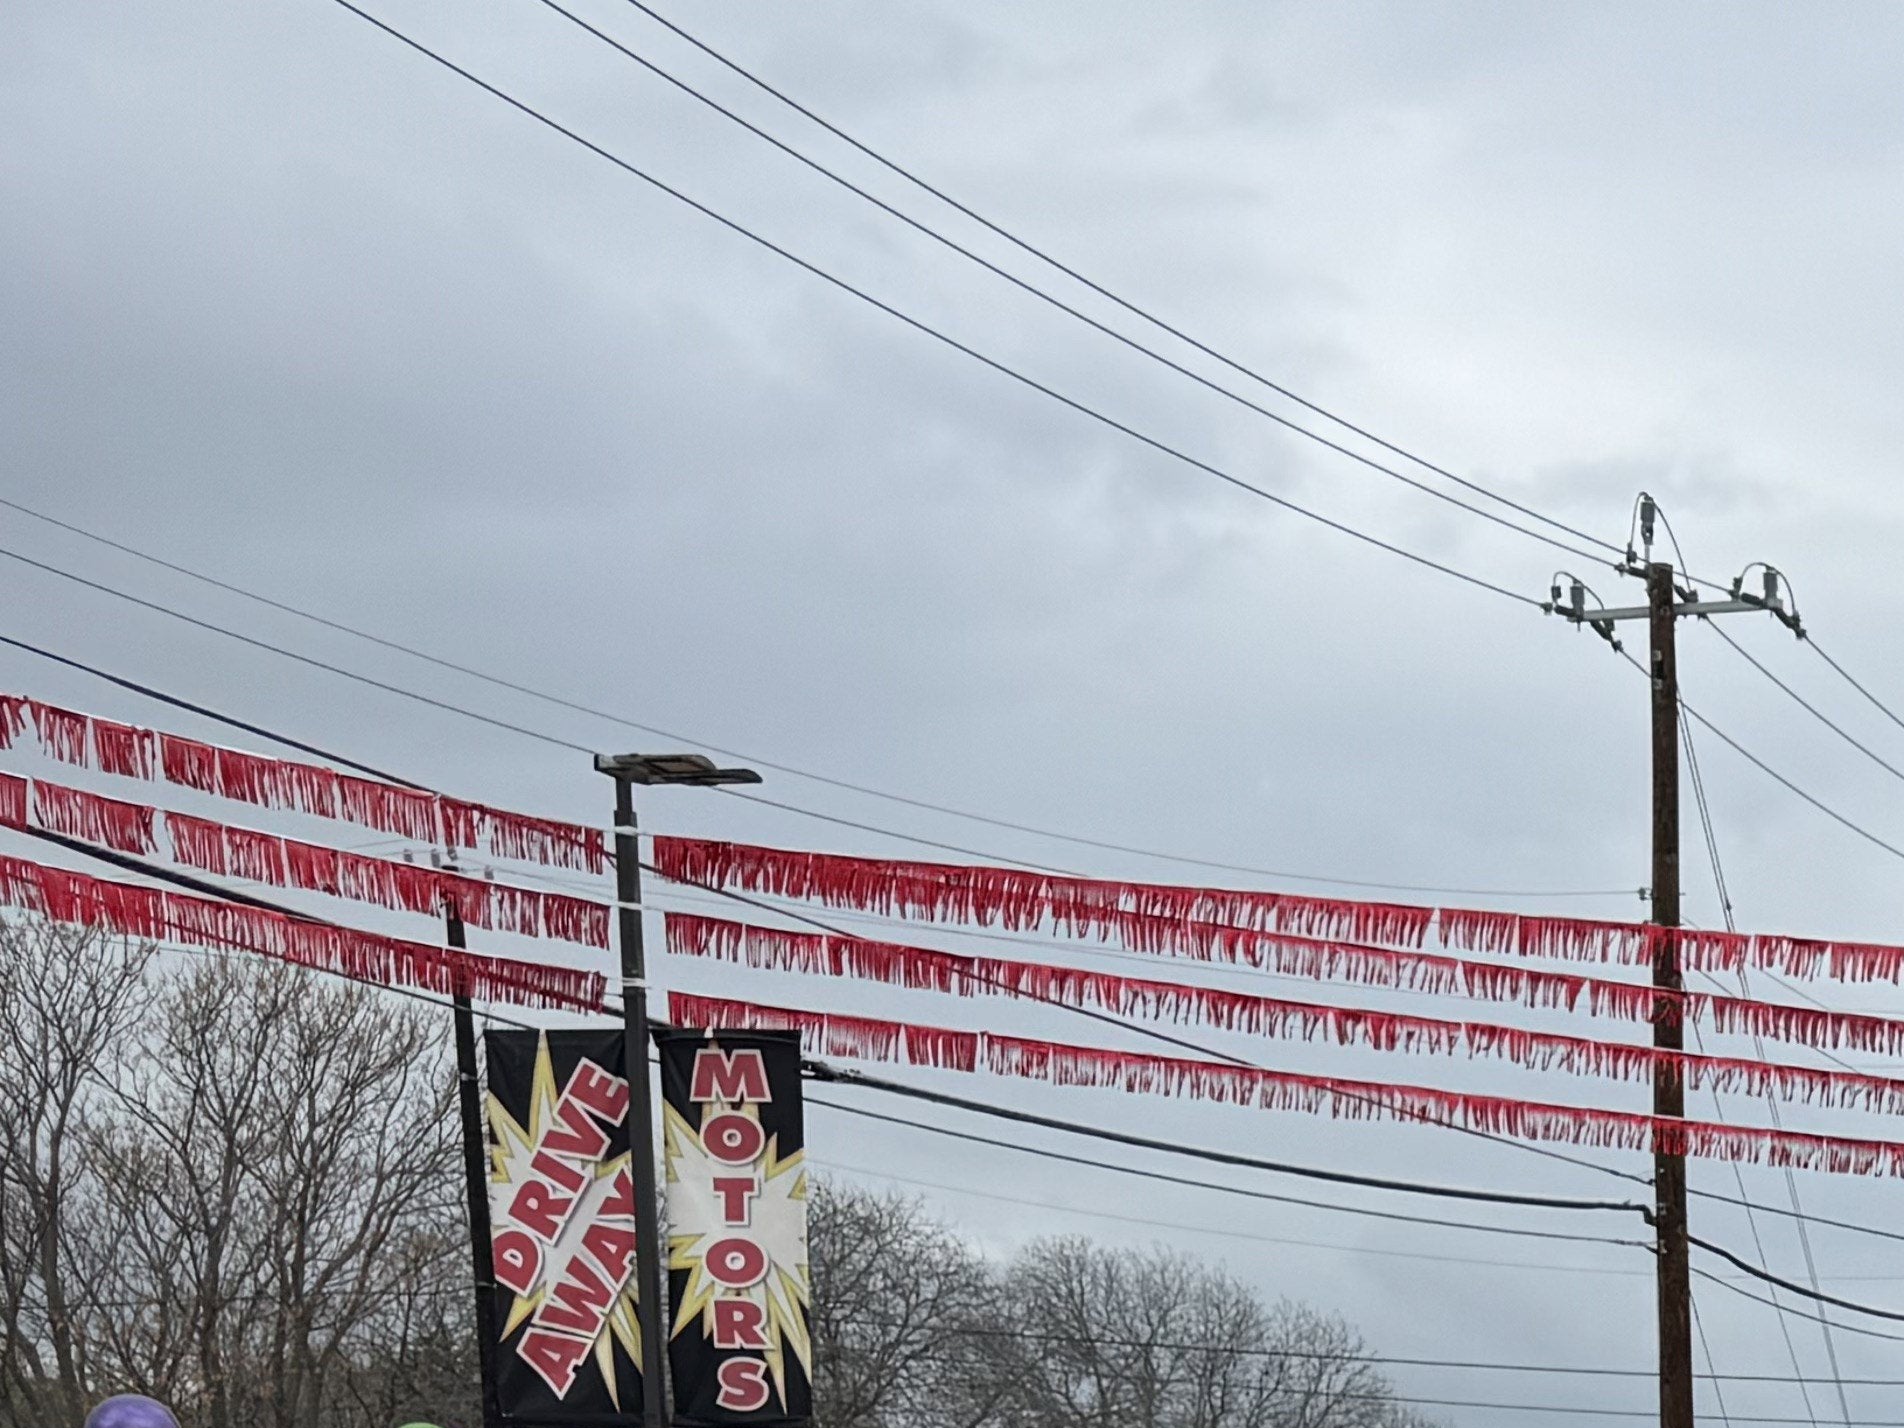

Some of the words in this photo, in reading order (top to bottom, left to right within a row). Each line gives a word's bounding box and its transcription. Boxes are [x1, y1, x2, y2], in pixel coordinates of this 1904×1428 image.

[493, 1057, 630, 1296] DRIVE
[516, 1165, 636, 1400] AWAY
[690, 1049, 773, 1411] MOTORS
